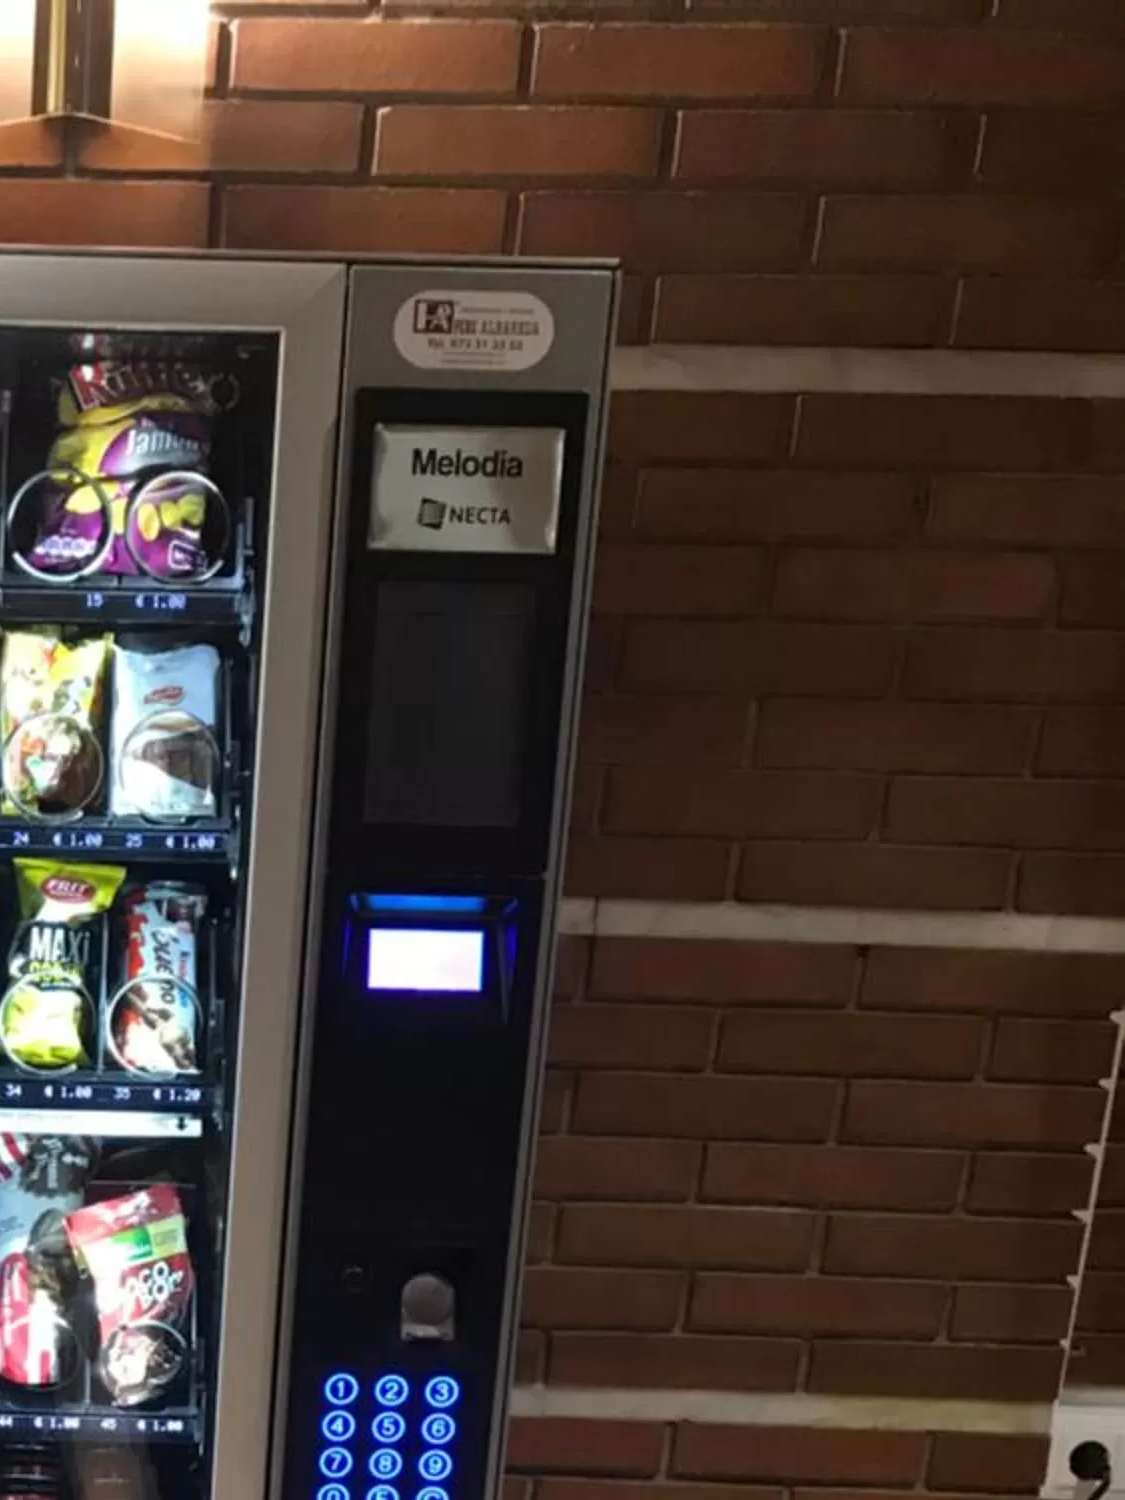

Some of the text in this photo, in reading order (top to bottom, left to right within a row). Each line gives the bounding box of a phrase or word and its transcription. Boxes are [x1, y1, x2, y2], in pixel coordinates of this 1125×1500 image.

[411, 448, 523, 478] Melodia
[448, 505, 511, 525] NECTA
[13, 831, 30, 845] 24
[69, 833, 103, 848] 1.00
[182, 836, 216, 850] 1.00
[5, 1083, 23, 1098] 34
